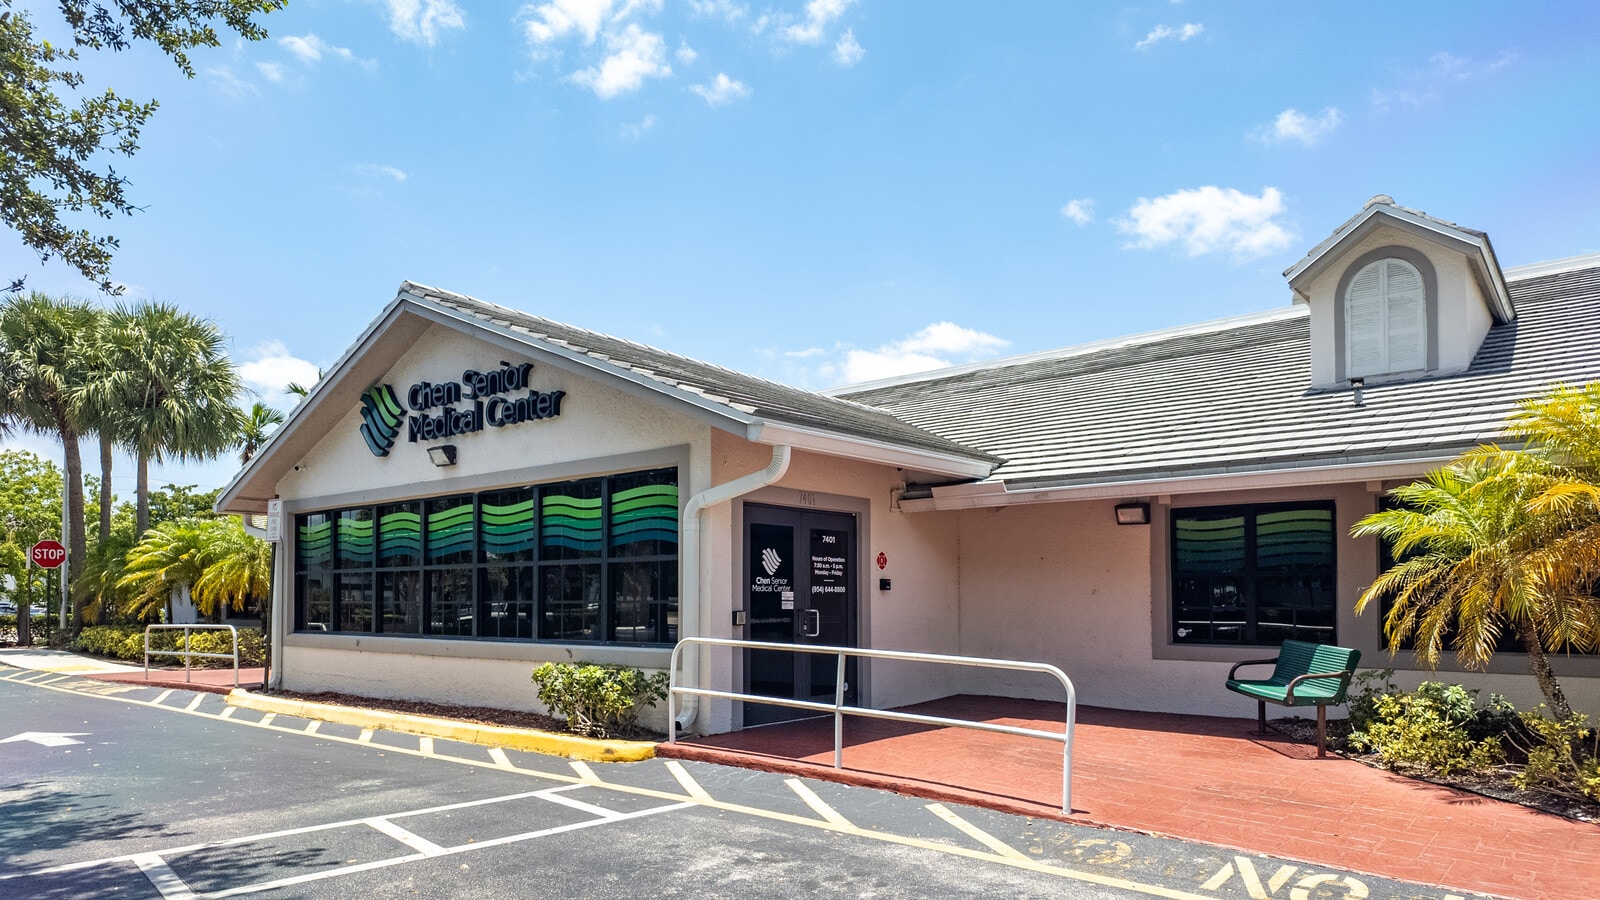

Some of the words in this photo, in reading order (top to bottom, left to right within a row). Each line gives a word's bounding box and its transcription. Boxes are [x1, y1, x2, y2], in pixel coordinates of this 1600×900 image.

[408, 382, 461, 411] Chen
[462, 361, 534, 399] Senior
[408, 400, 484, 442] Medical
[486, 390, 566, 427] Center
[822, 535, 836, 544] 7401
[34, 548, 64, 560] STOP
[755, 576, 770, 585] Chen
[771, 576, 787, 585] Senior
[752, 584, 773, 592] Medical
[773, 584, 791, 592] Center
